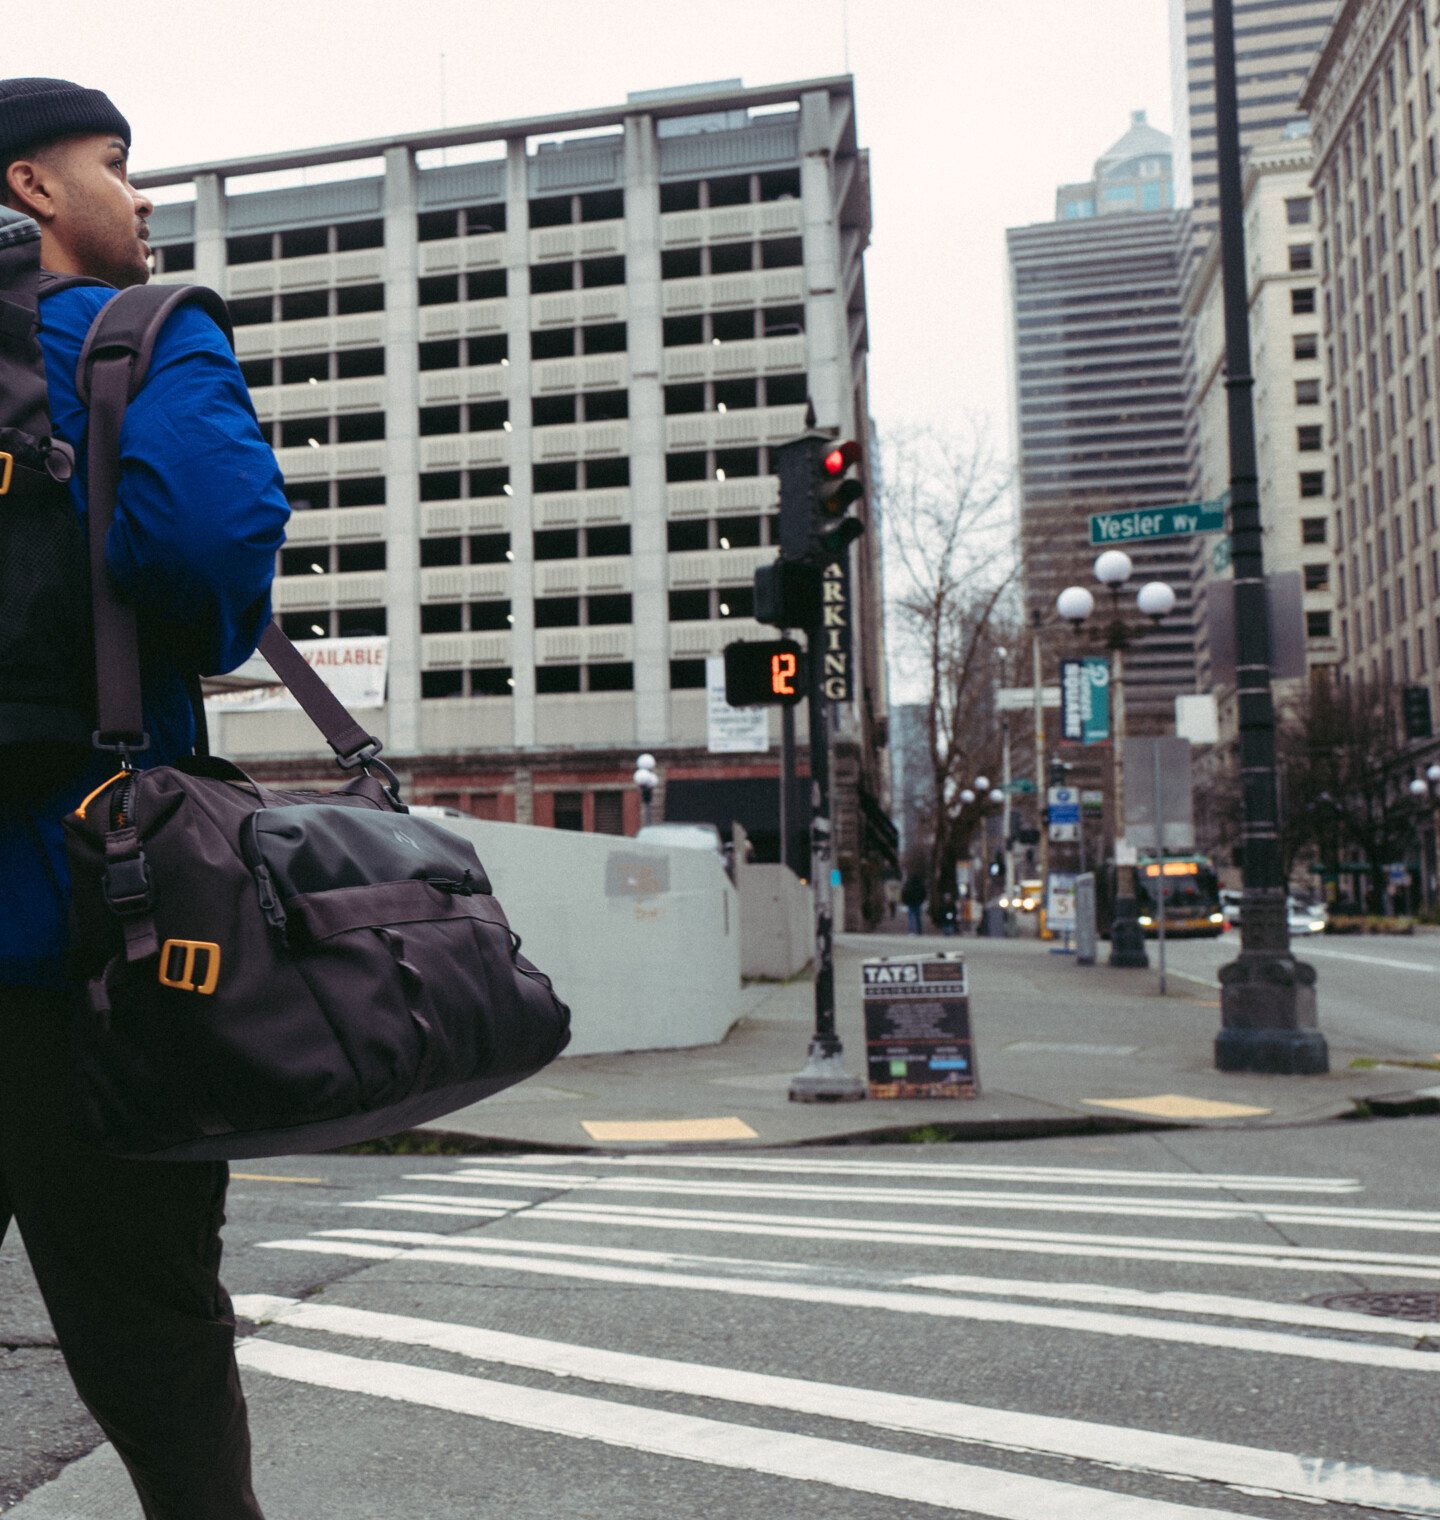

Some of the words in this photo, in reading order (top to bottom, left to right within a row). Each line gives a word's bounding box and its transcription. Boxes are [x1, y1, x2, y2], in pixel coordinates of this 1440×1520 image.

[1097, 512, 1164, 539] Yesler
[1172, 514, 1198, 532] Wy
[823, 562, 846, 699] ARKING
[771, 653, 796, 695] 12
[865, 966, 917, 982] TATS
